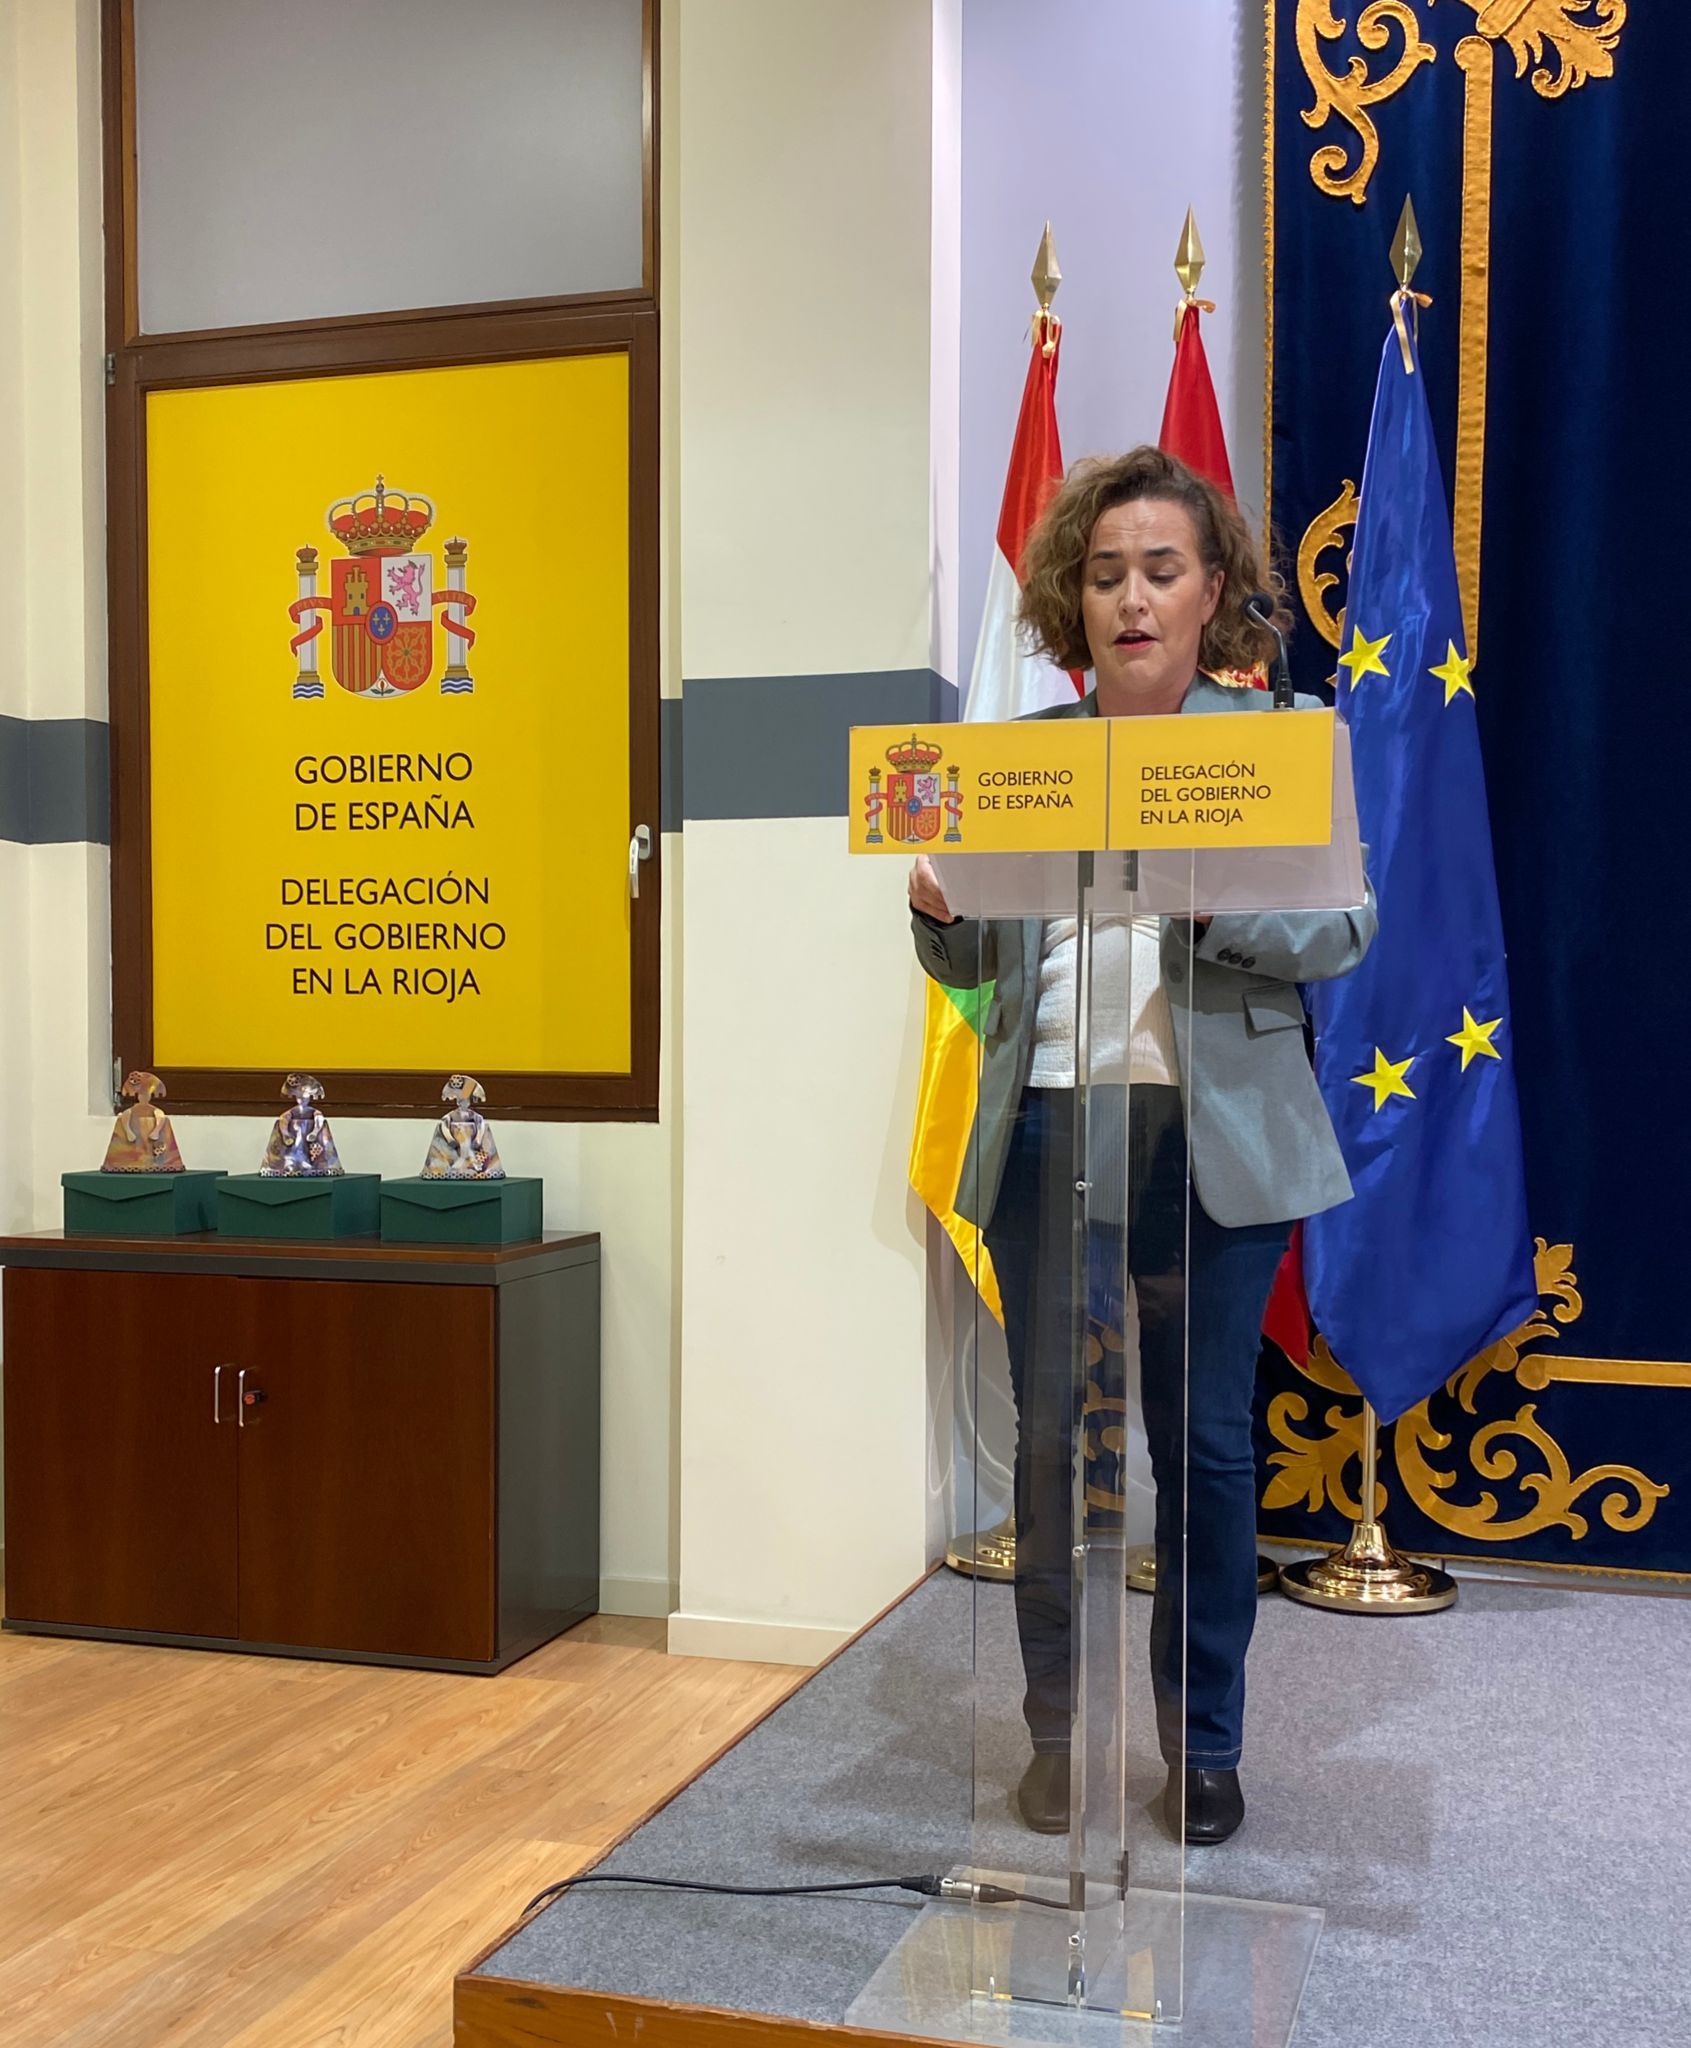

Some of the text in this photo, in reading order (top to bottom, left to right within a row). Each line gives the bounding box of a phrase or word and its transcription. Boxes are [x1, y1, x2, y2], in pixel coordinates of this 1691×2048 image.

[295, 752, 473, 784] GOBIERNO
[978, 769, 1073, 787] GOBIERNO
[1141, 760, 1255, 781] DELEGACIÓN
[978, 795, 1001, 810] DE
[1006, 790, 1074, 809] ESPAÑA
[1141, 785, 1271, 803] DEL GOBIERNO
[295, 794, 475, 831] DE ESPAÑA
[1140, 808, 1243, 827] EN LA RIOJA
[281, 870, 489, 906] DELEGACIÓN
[265, 922, 506, 950] DEL GOBIERNO
[293, 968, 481, 1004] EN LA RIOJA
